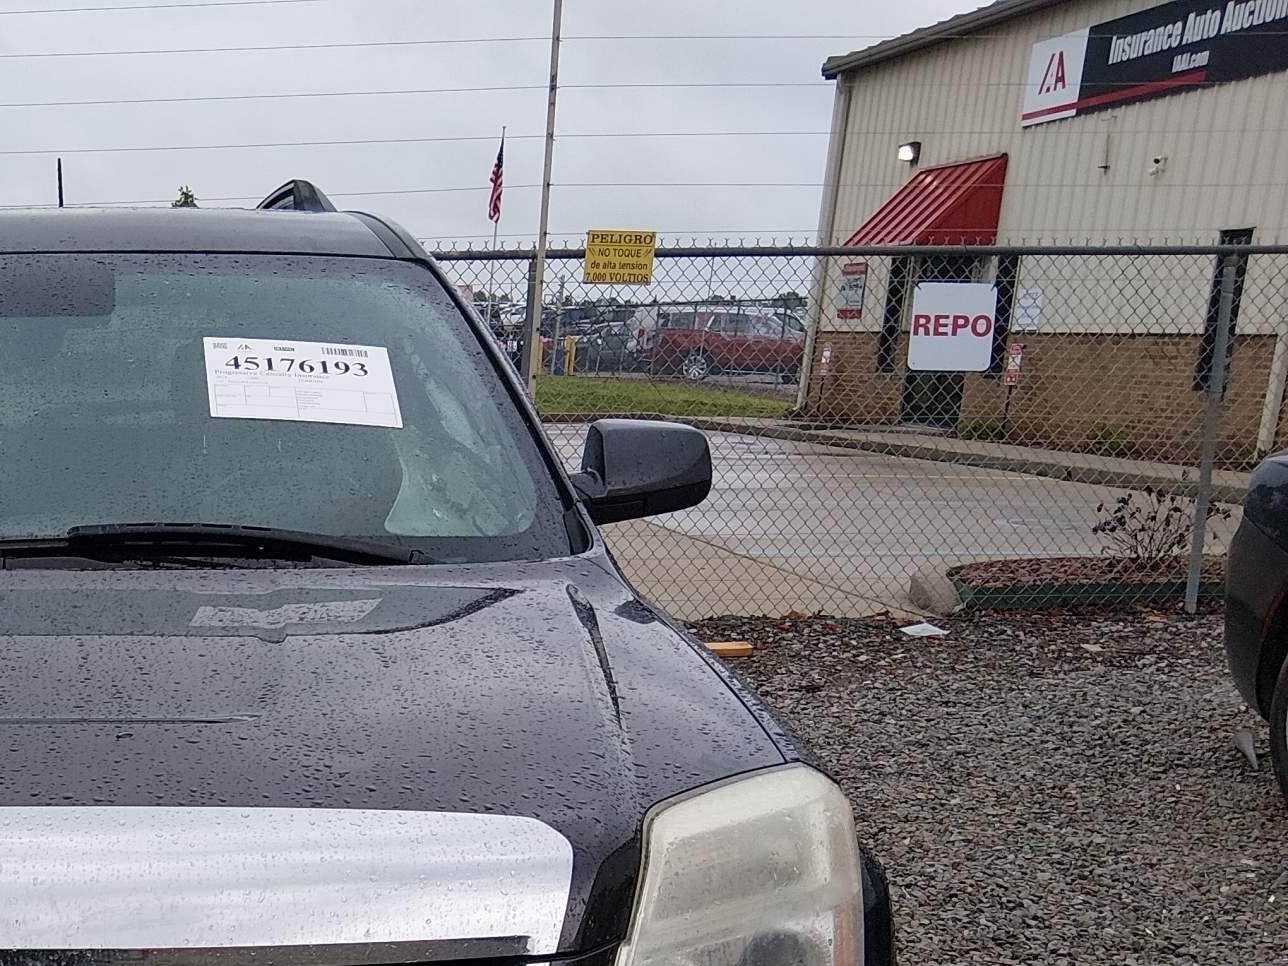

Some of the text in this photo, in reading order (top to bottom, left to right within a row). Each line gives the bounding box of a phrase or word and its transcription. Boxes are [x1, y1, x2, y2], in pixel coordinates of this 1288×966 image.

[1107, 0, 1288, 65] Insurance Auto Auction
[591, 233, 653, 245] PELIGRO
[598, 248, 642, 258] NO TOQUE
[590, 260, 648, 270] de alta tension
[609, 273, 649, 283] VOLTIOS
[913, 314, 992, 338] REPO
[224, 355, 369, 377] 45176193
